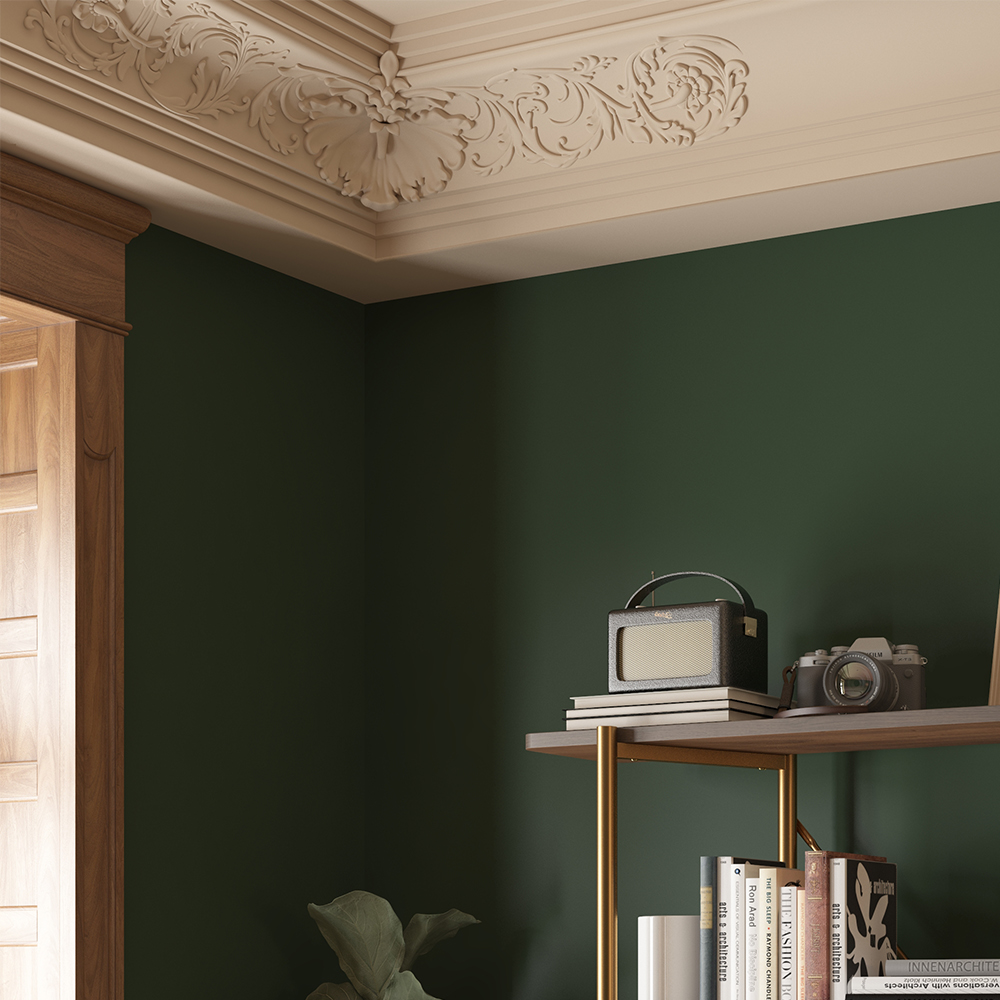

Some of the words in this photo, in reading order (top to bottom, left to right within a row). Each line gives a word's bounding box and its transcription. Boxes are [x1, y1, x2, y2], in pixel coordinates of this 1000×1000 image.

[749, 885, 757, 902] Ron
[782, 889, 791, 917] THE
[749, 905, 757, 926] Arad
[832, 903, 841, 919] arts
[782, 920, 791, 979] FASHION
[832, 933, 842, 983] architecture
